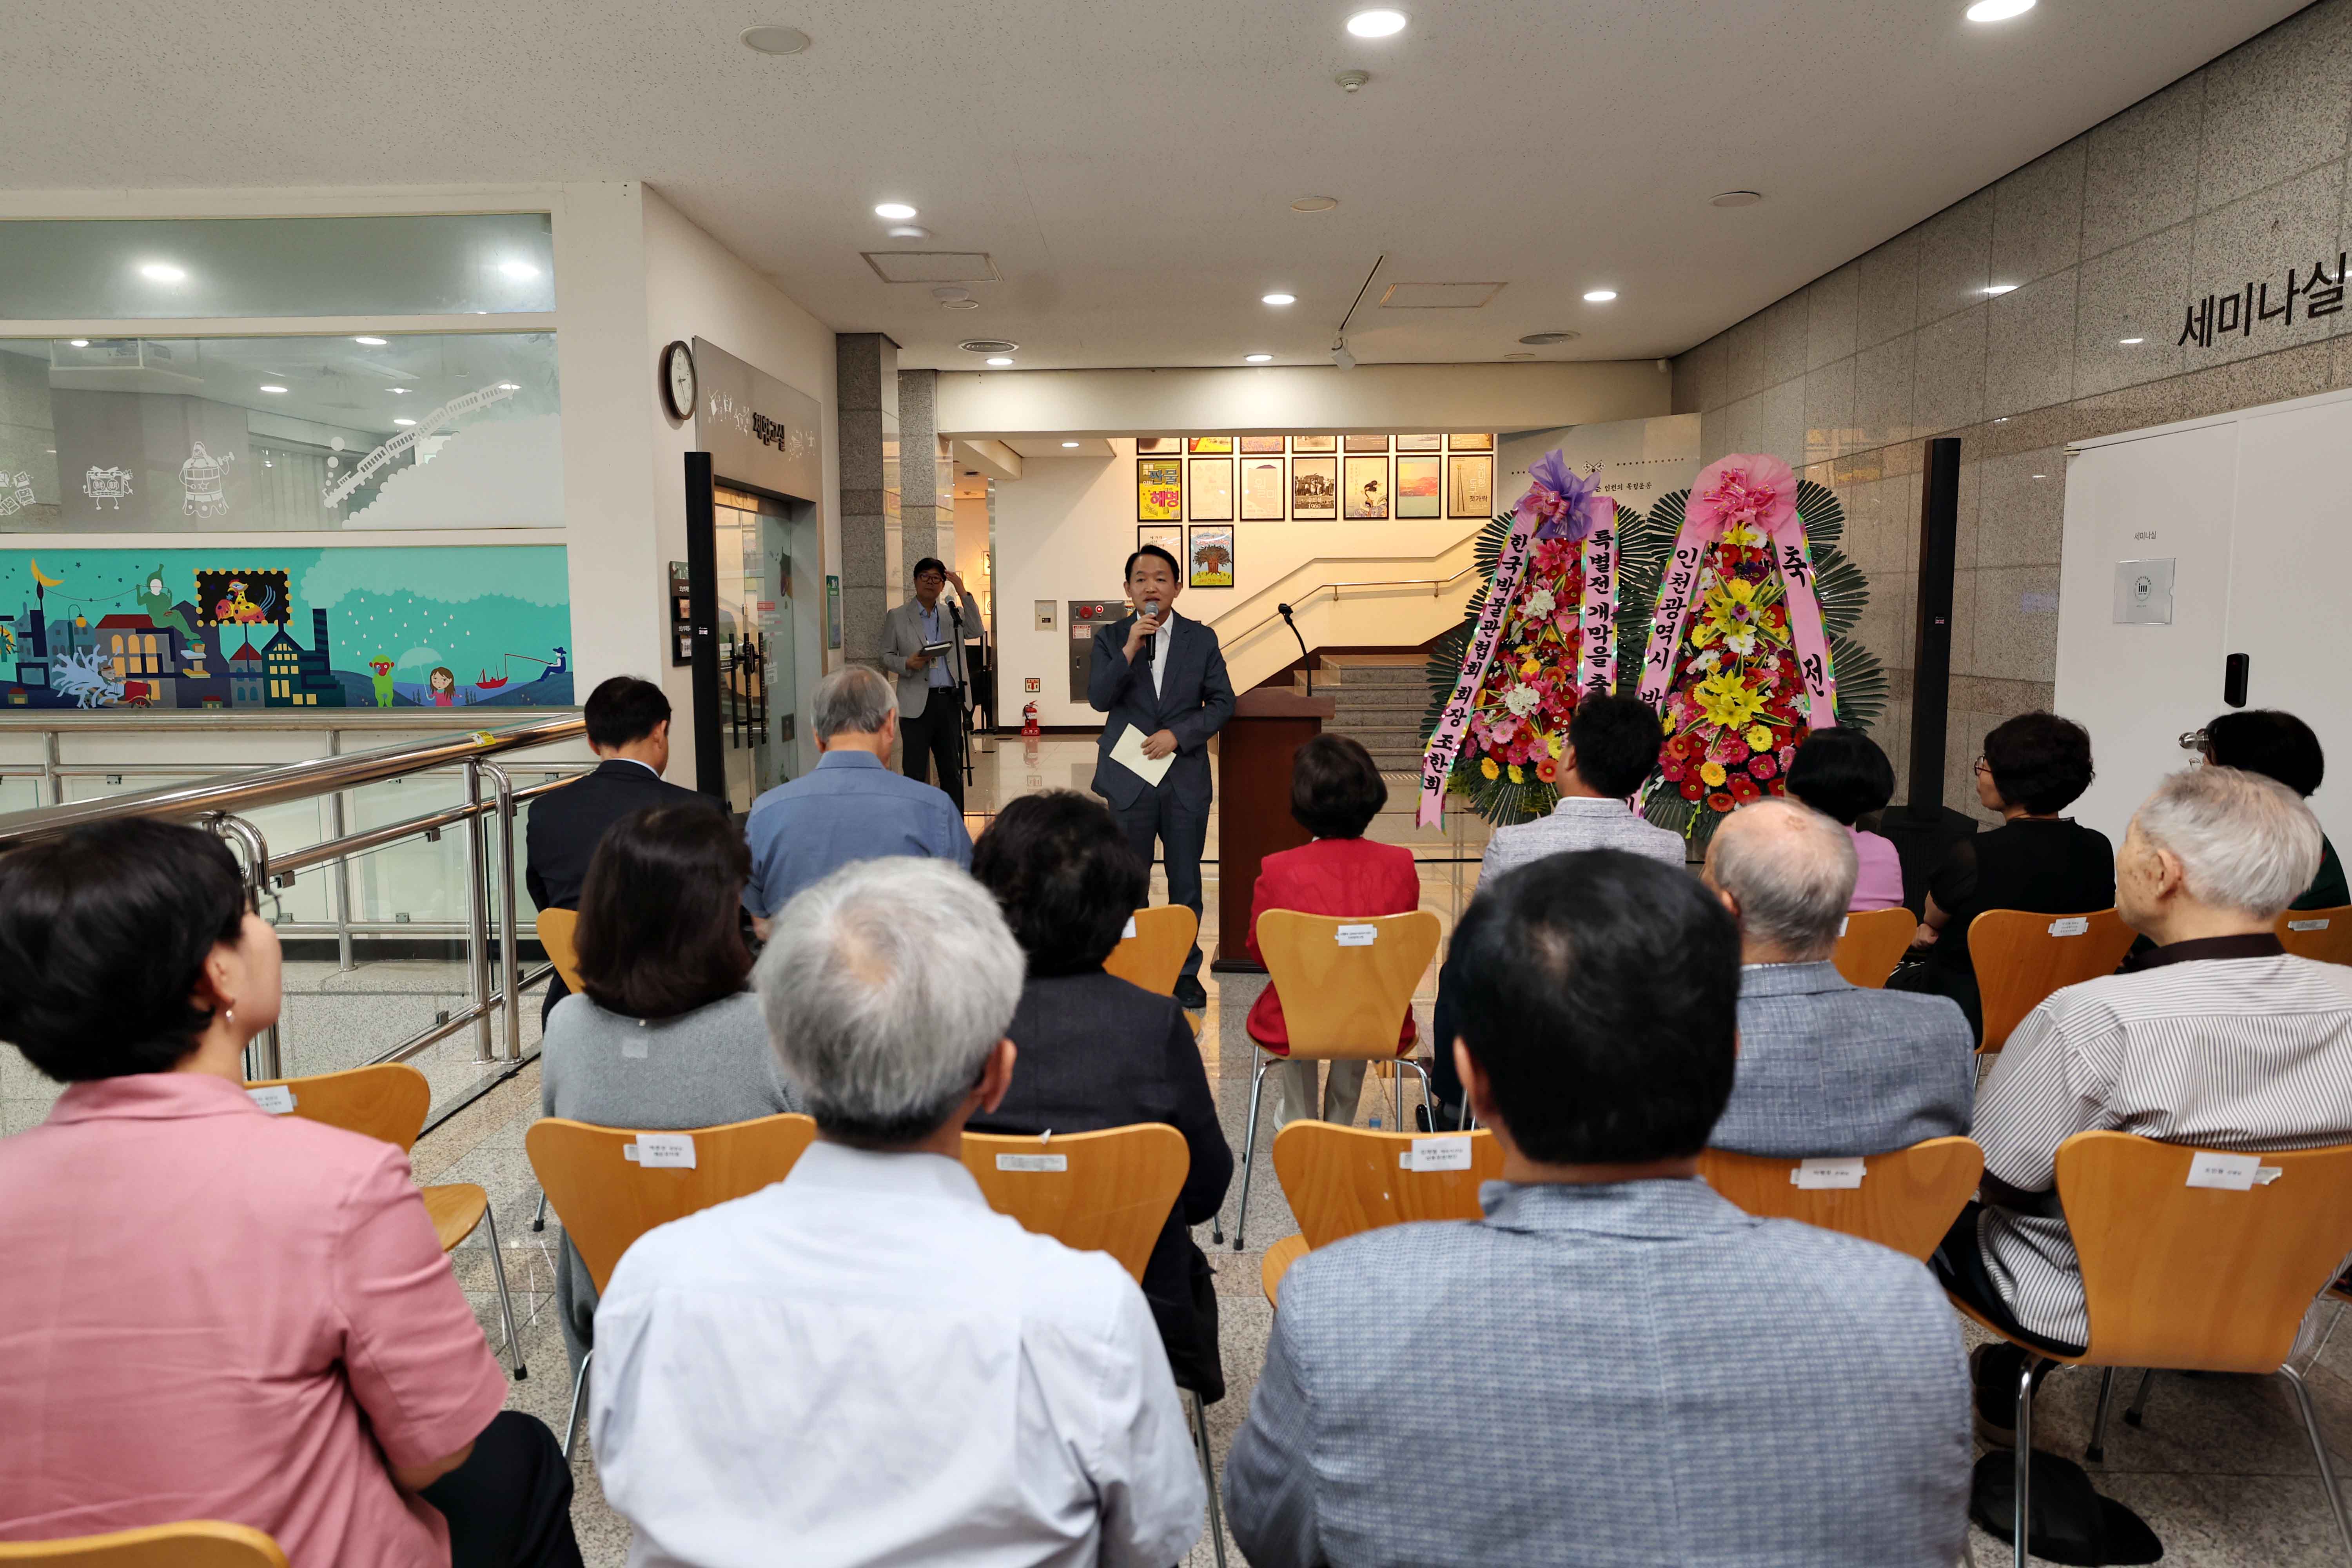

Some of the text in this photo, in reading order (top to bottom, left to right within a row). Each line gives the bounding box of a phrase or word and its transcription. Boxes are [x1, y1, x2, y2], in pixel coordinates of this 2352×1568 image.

[2177, 252, 2347, 348] 세미나실
[753, 412, 785, 452] 체험교실
[1626, 481, 1652, 490] 독립운동
[1587, 529, 1614, 595] 특별전
[2134, 531, 2157, 541] 세미나실
[1463, 534, 1528, 680] 한국박물관협회
[1586, 602, 1613, 668] 개막을
[1648, 547, 1698, 671] 인천광역시
[1446, 686, 1473, 728] 회장
